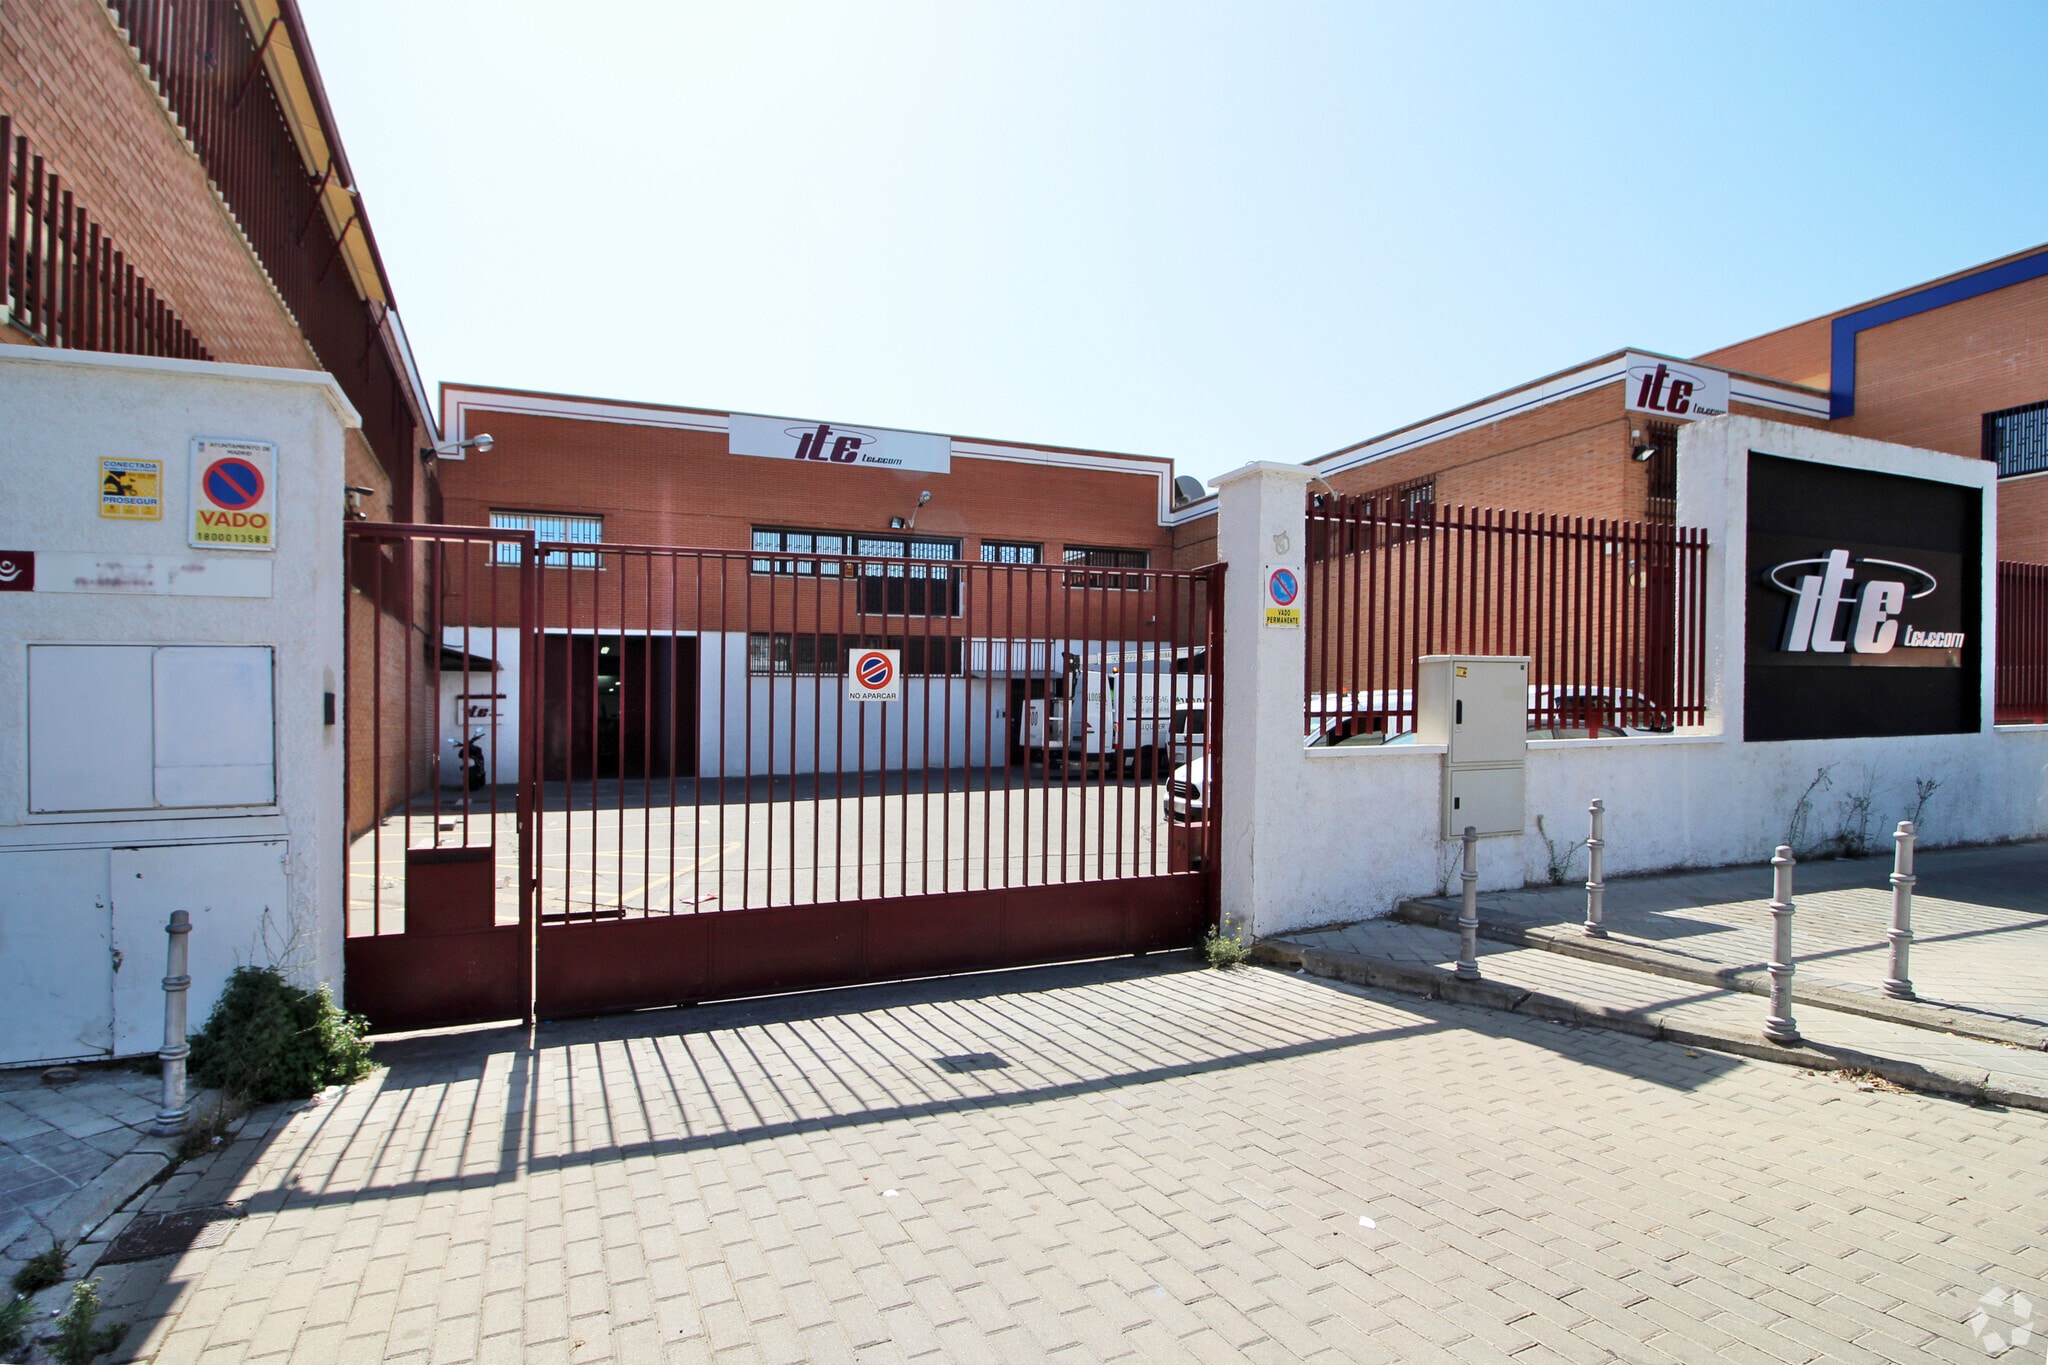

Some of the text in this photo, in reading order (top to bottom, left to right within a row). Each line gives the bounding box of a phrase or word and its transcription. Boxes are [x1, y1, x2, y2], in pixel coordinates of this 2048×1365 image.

[209, 442, 261, 451] AYUNTAMIENTO
[103, 461, 157, 469] CONECTADA
[103, 496, 158, 505] PROSEGUR
[200, 510, 267, 529] VADO
[1266, 616, 1298, 624] PERMANENTE
[1904, 624, 1965, 649] telecom
